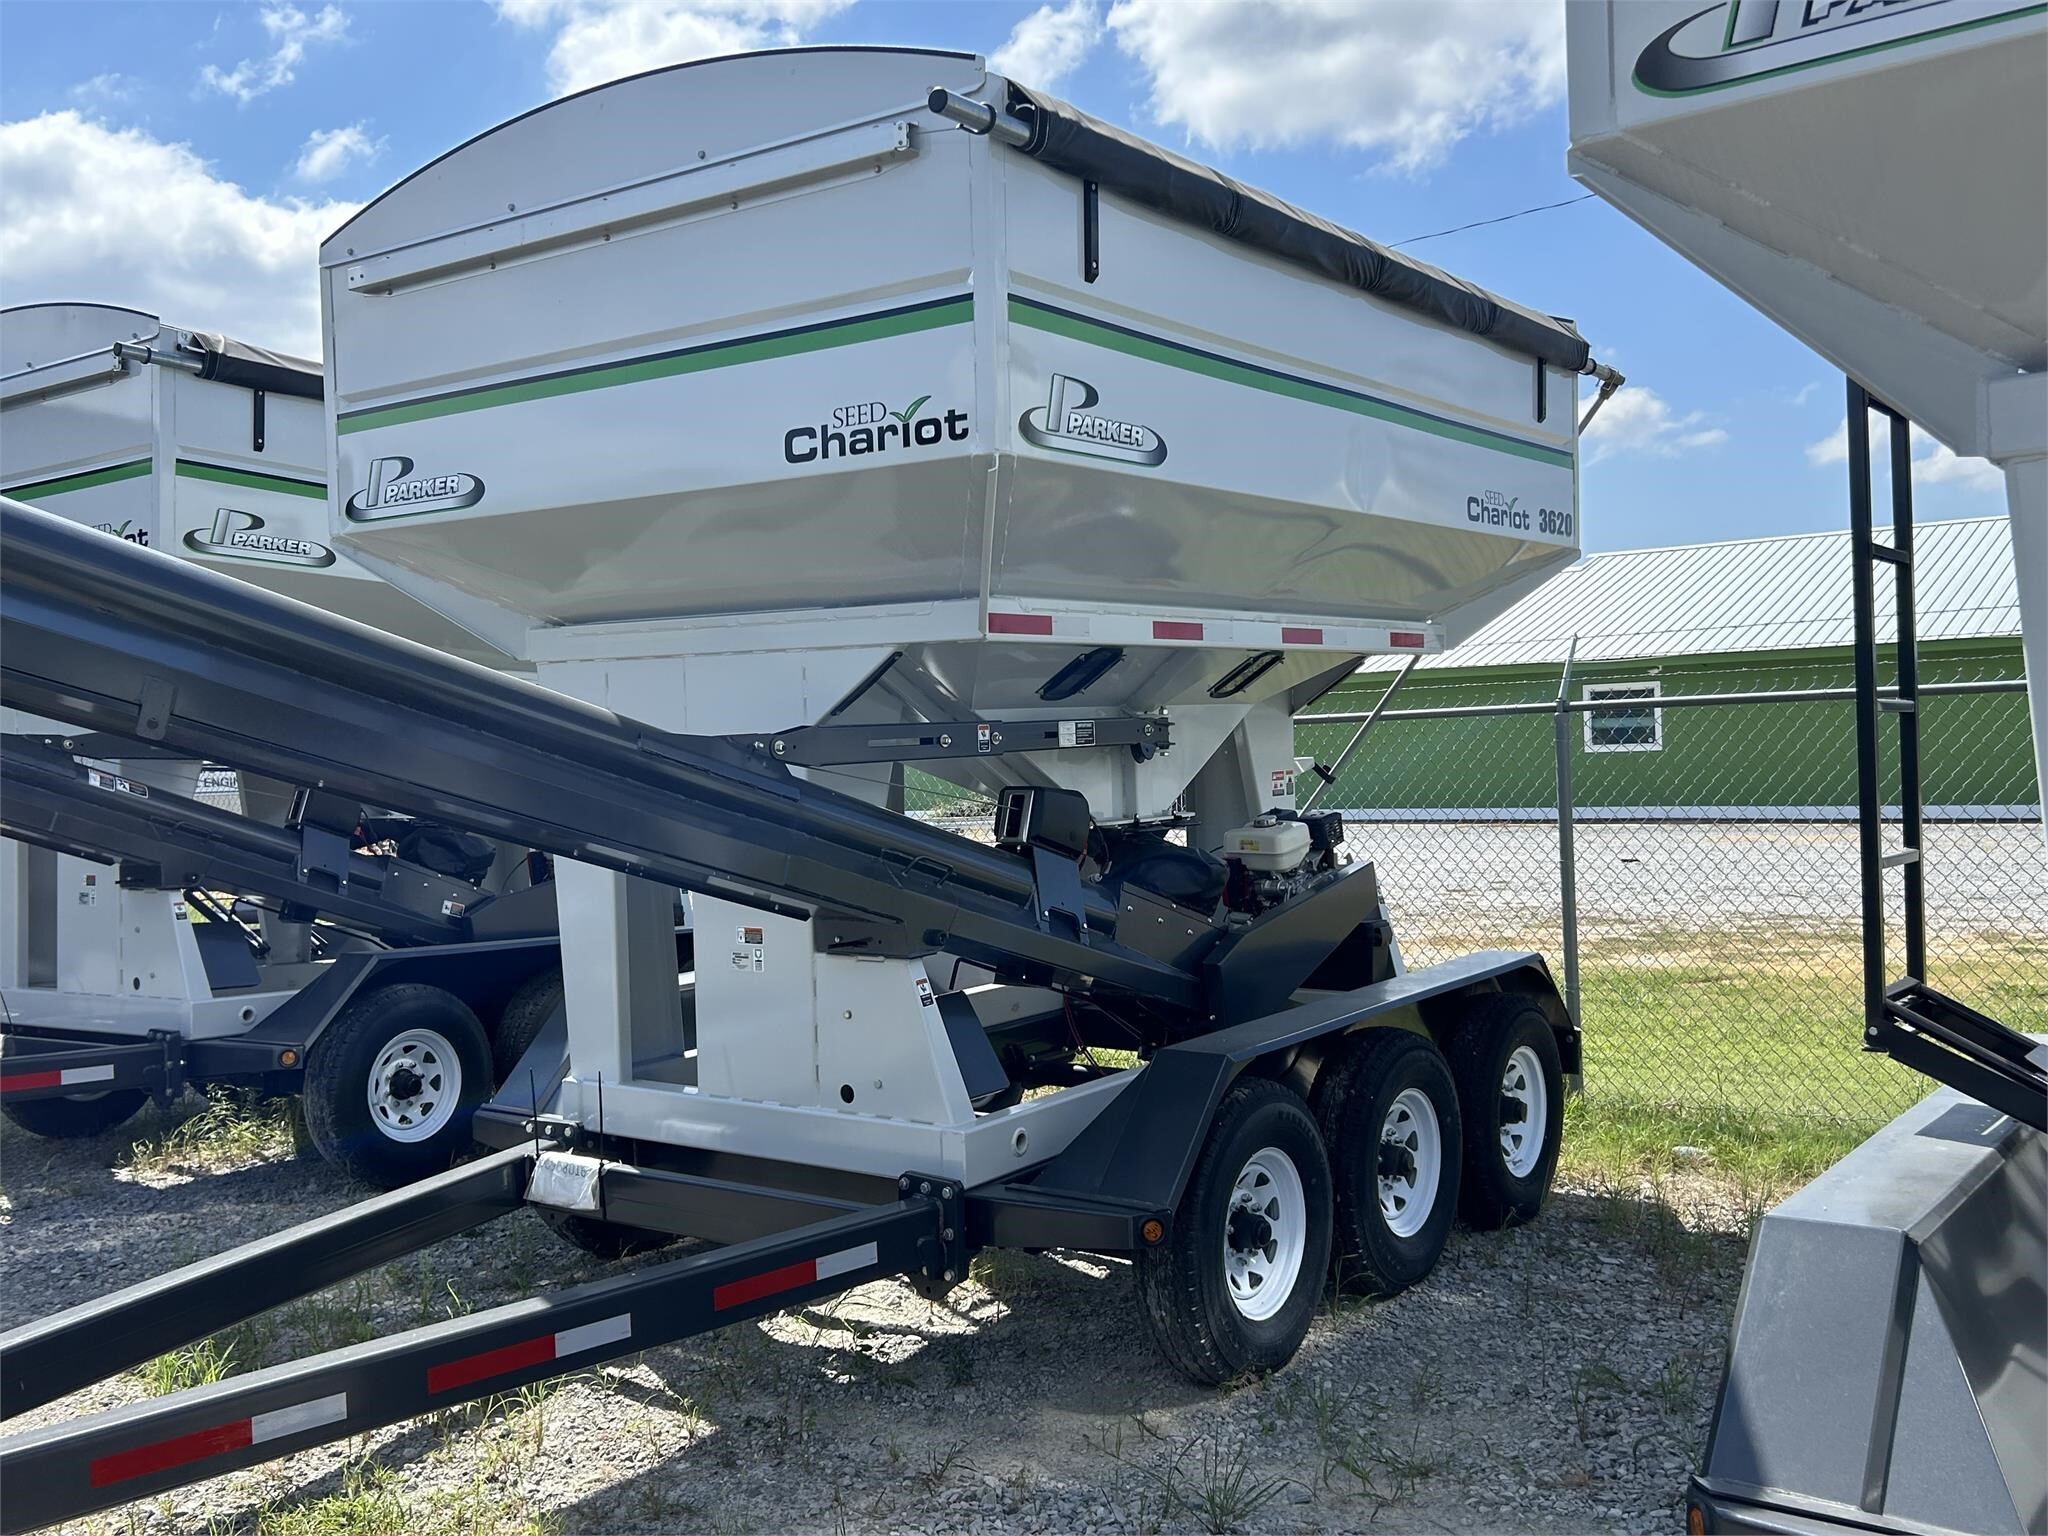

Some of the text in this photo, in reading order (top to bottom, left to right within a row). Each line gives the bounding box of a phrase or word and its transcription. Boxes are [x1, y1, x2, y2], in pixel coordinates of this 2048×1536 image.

[833, 402, 887, 429] SEED
[1067, 412, 1144, 446] PARKER
[784, 408, 969, 464] Chariot
[384, 475, 460, 504] PARKER
[1484, 490, 1505, 507] SEED
[1466, 496, 1573, 537] Chariot 3620
[231, 532, 313, 556] PARKER
